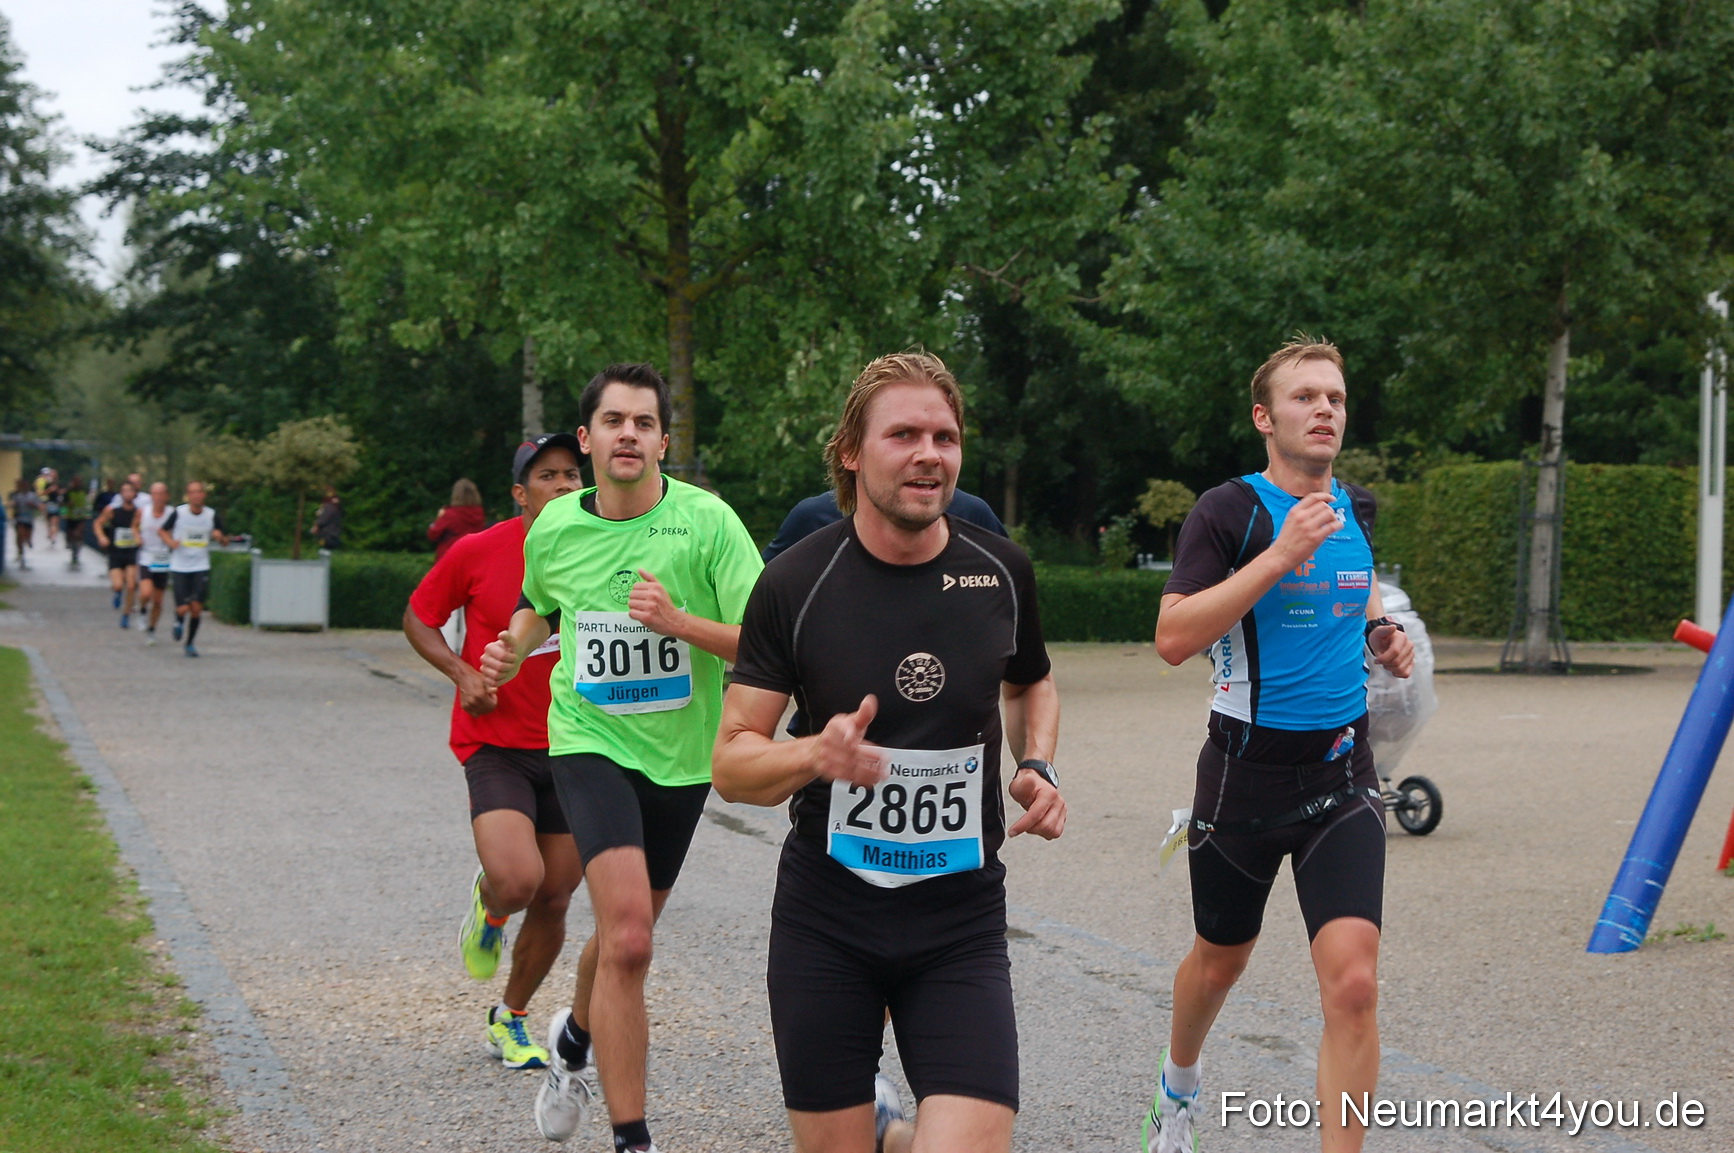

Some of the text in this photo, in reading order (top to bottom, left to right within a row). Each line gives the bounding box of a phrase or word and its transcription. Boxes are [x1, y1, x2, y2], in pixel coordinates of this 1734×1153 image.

[661, 527, 688, 536] DEKRA
[959, 575, 999, 588] DEKRA
[578, 622, 653, 633] PARTL Neuma
[587, 637, 680, 677] 3016
[607, 686, 659, 702] Jürgen
[890, 763, 959, 778] Neumarkt
[846, 781, 967, 835] 2865
[834, 822, 841, 832] A
[863, 844, 948, 870] Matthias
